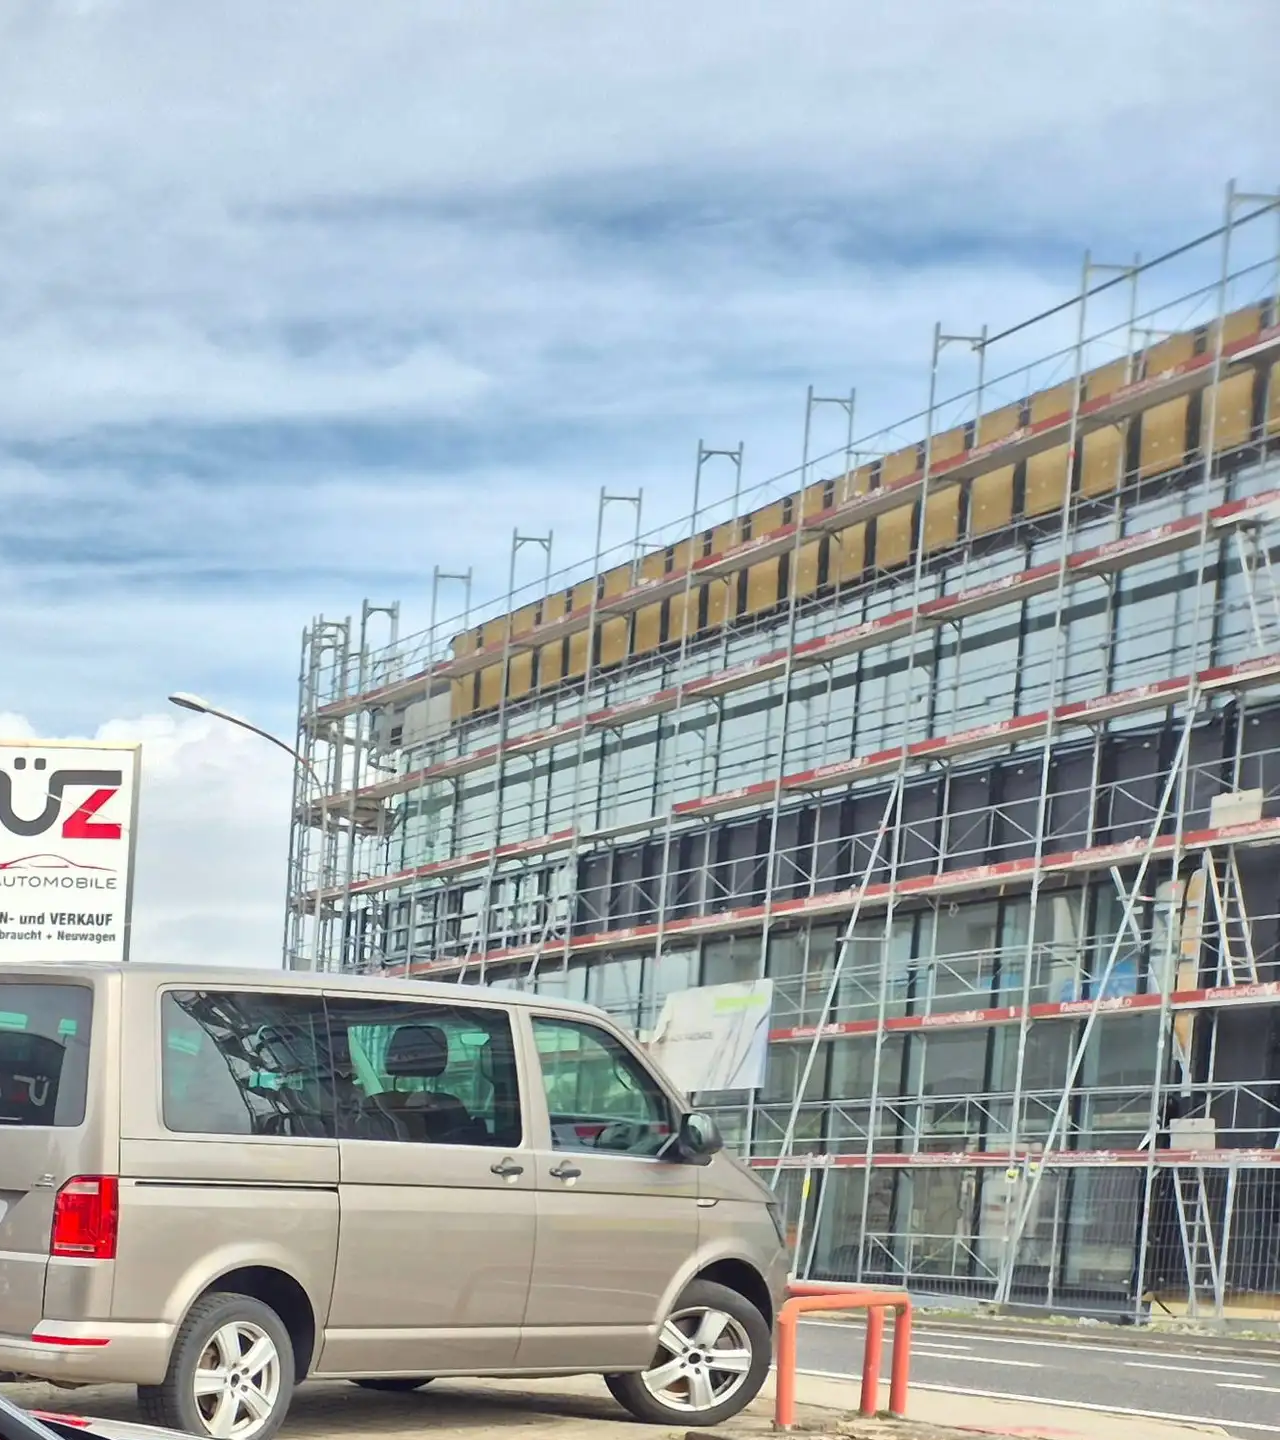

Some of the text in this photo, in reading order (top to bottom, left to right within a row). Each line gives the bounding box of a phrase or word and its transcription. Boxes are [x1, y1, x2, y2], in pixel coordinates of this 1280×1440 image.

[19, 912, 45, 925] und
[50, 913, 113, 926] VERKAUF
[57, 930, 116, 944] Neuwagen
